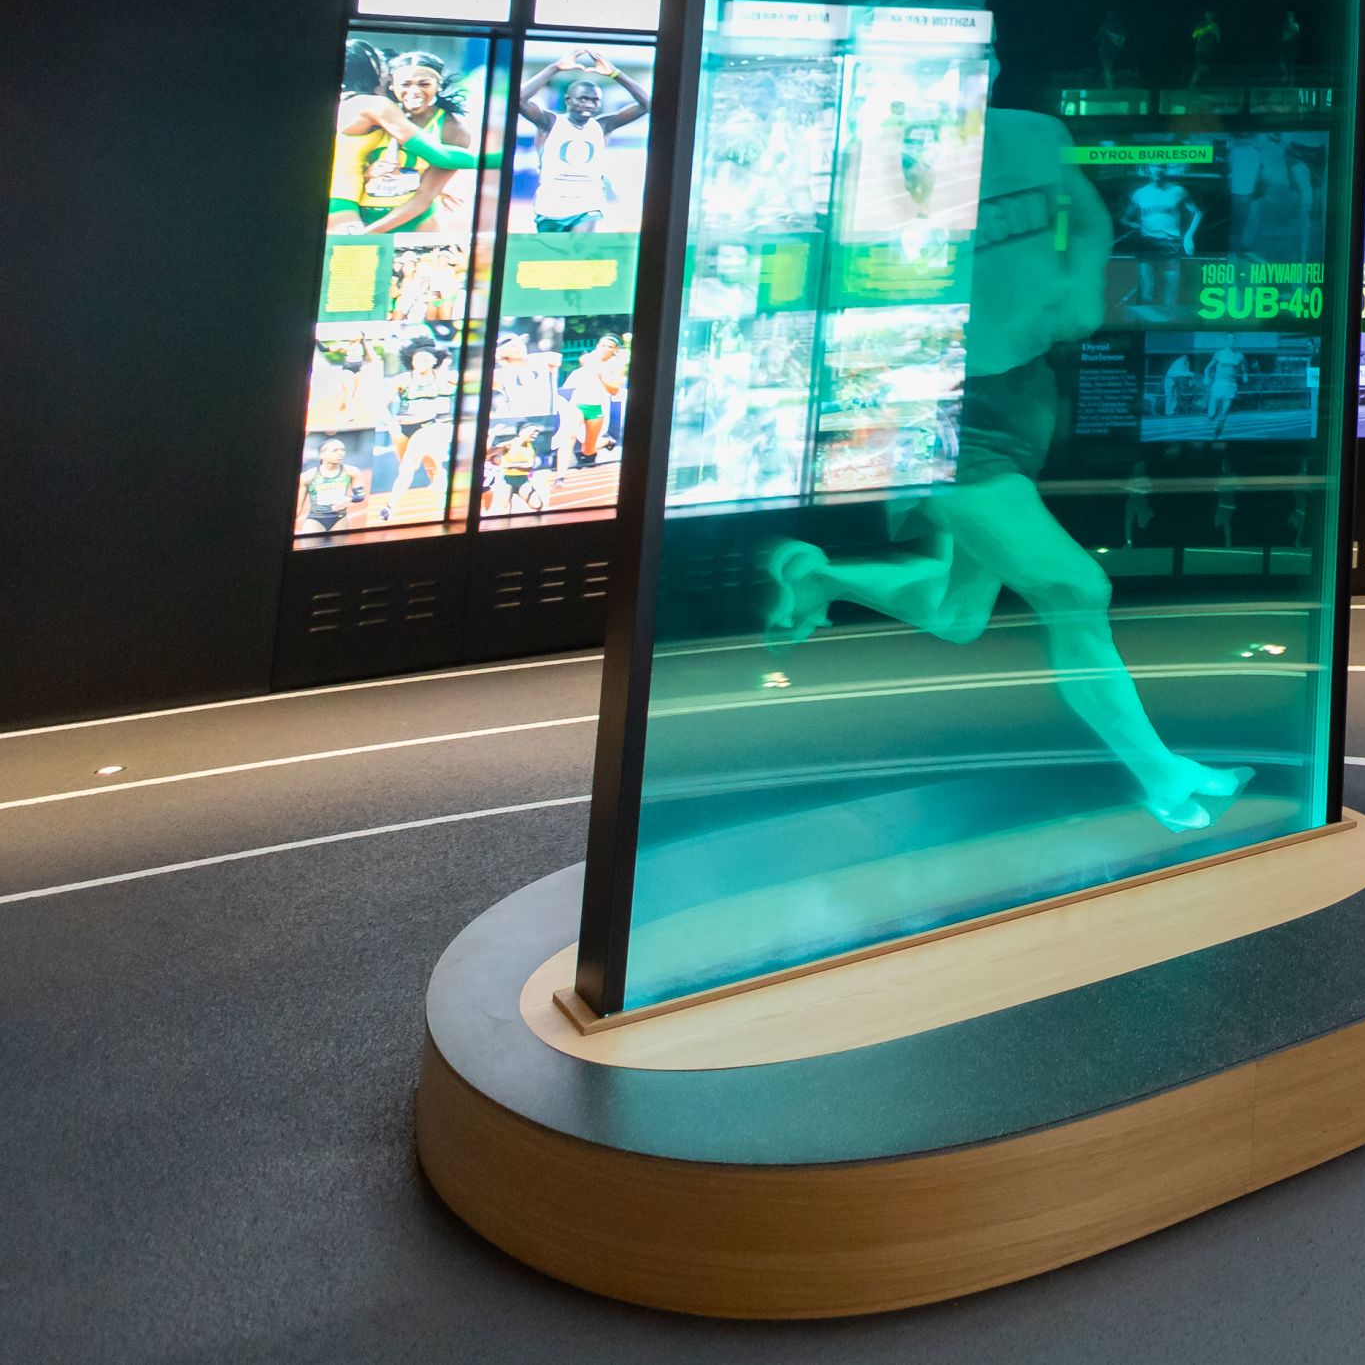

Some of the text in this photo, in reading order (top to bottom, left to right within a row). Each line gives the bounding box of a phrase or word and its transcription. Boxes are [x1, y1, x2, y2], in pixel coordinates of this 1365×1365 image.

[1089, 148, 1207, 161] DYROL BURLESON
[1201, 264, 1235, 285] 1960
[1250, 263, 1303, 285] HAYWARD
